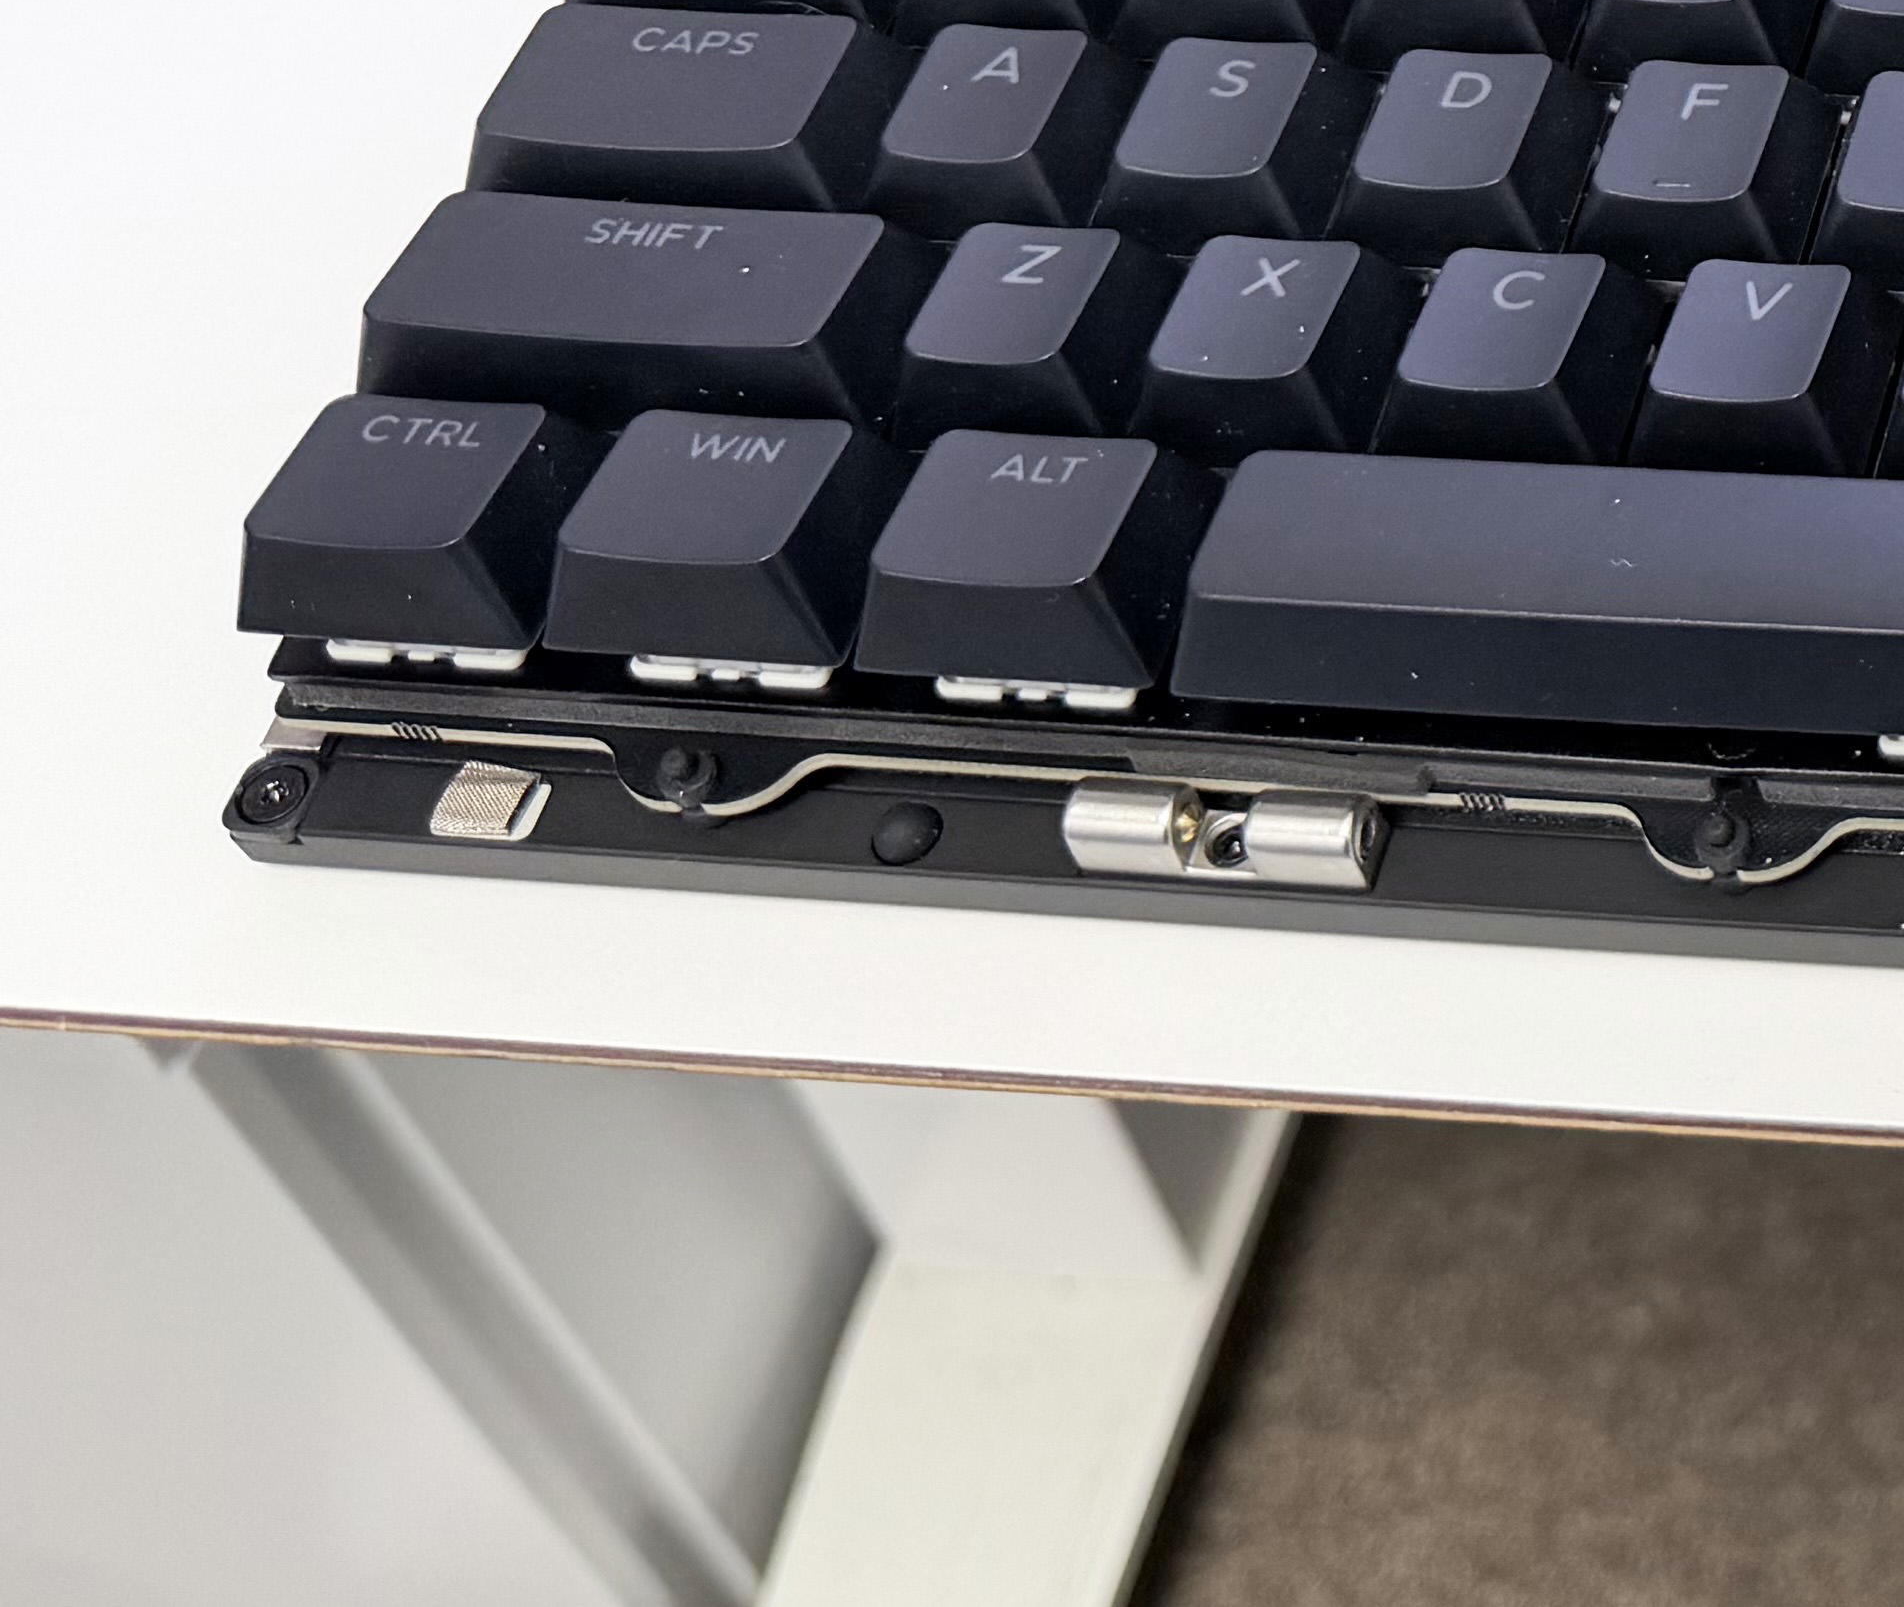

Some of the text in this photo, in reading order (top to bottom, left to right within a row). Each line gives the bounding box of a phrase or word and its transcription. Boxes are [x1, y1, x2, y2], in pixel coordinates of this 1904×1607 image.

[631, 26, 760, 56] CAPS
[971, 46, 1020, 84] A
[1209, 59, 1256, 98] S
[1439, 70, 1493, 109] D
[1680, 82, 1729, 121] F
[584, 217, 724, 250] SHIFT
[1001, 244, 1062, 285] Z
[1241, 258, 1301, 298] X
[1492, 270, 1546, 311] C
[1745, 280, 1793, 321] V
[361, 414, 480, 448] CTRL
[690, 433, 787, 464] WIN
[990, 453, 1089, 484] ALT
